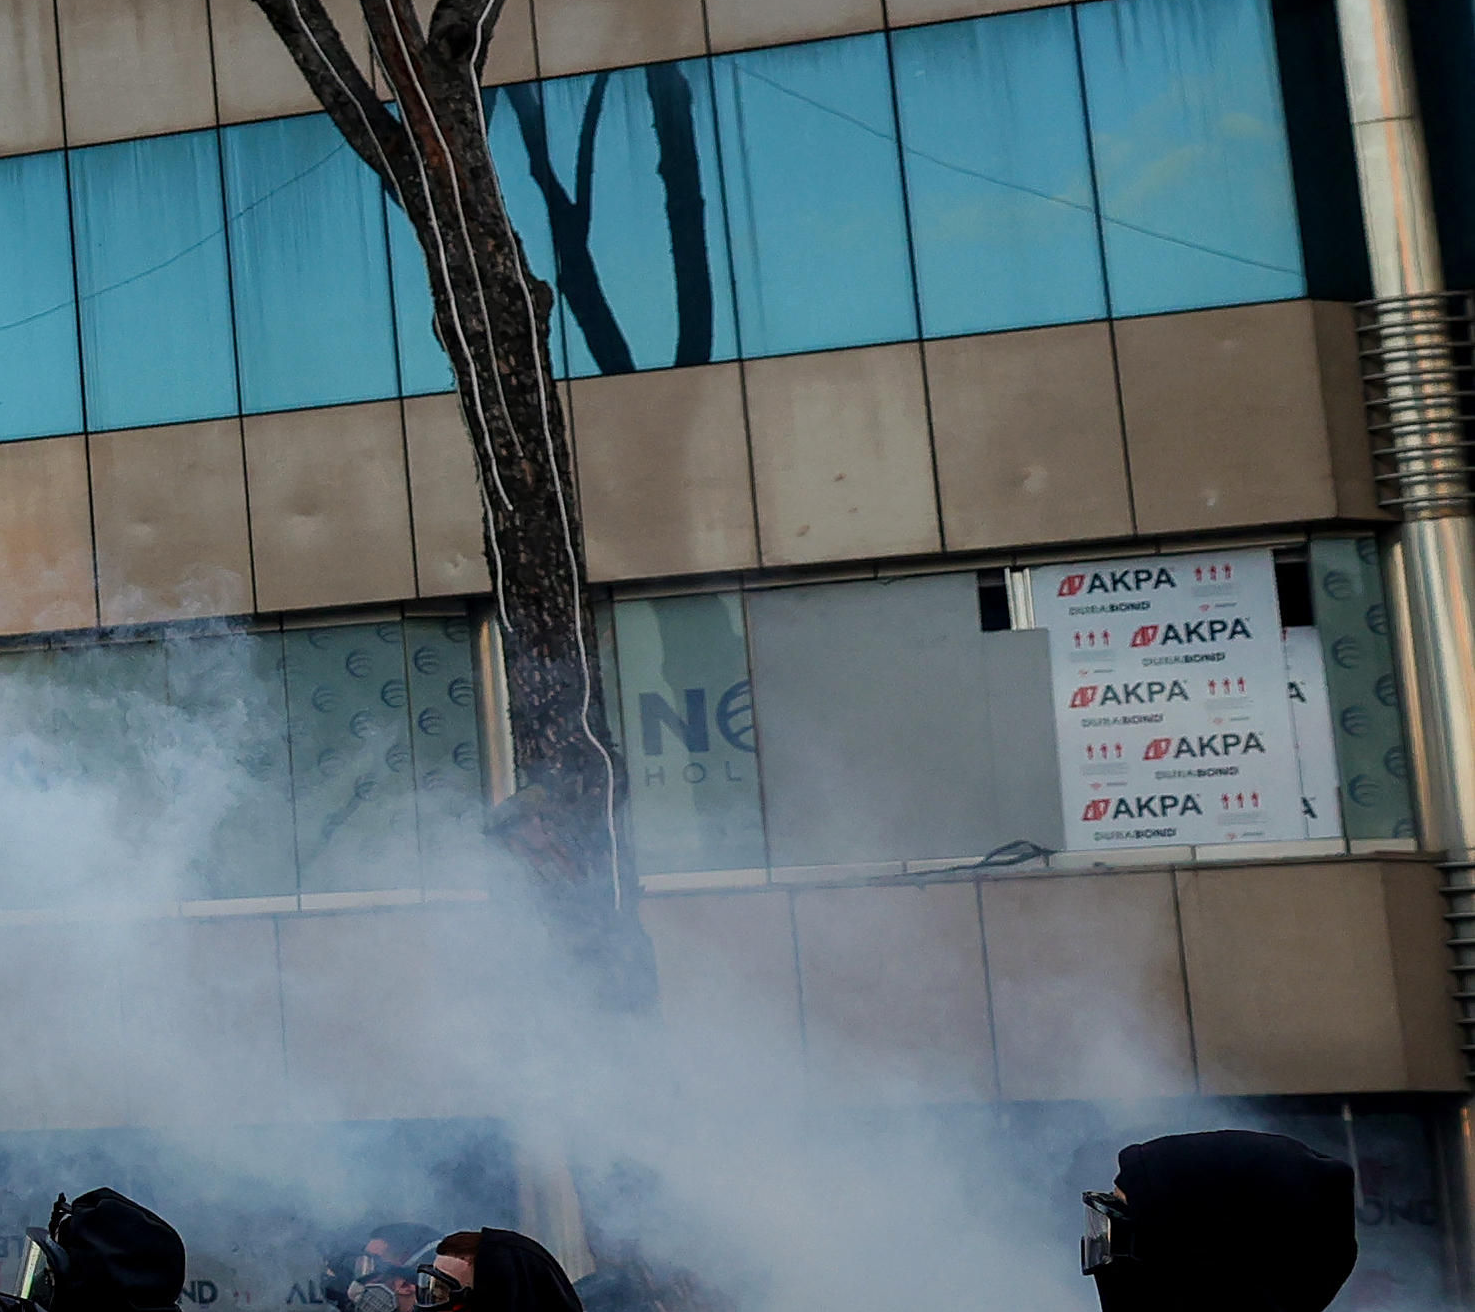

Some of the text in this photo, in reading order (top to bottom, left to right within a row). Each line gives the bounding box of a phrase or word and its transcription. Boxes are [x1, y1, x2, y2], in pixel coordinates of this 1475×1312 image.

[1087, 567, 1176, 594] AKPA
[1160, 617, 1252, 646] AKPA
[1100, 680, 1189, 706] AKPA
[1173, 732, 1265, 759] AKPA
[1112, 793, 1203, 820] AKPA
